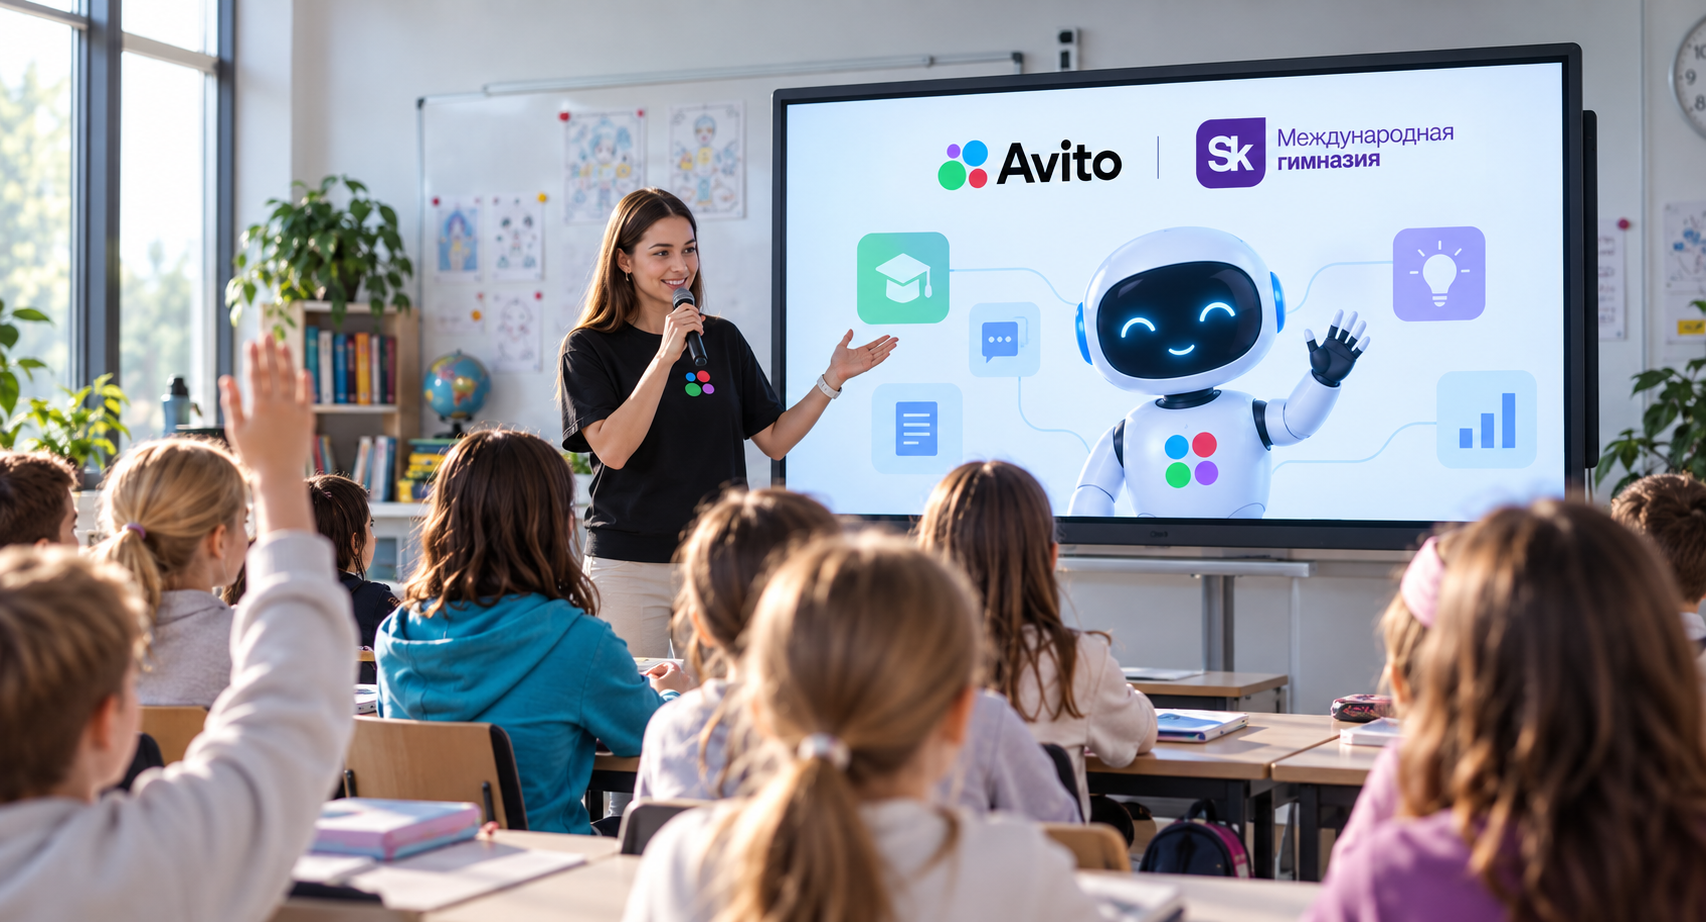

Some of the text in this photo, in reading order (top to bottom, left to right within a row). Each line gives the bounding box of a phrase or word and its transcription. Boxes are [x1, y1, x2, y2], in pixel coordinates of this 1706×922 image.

[1685, 68, 1697, 86] 9
[1694, 94, 1706, 112] 8
[1277, 126, 1454, 149] Международная
[996, 138, 1123, 185] Avito
[1207, 135, 1255, 173] Sk
[1277, 152, 1381, 171] гимназия
